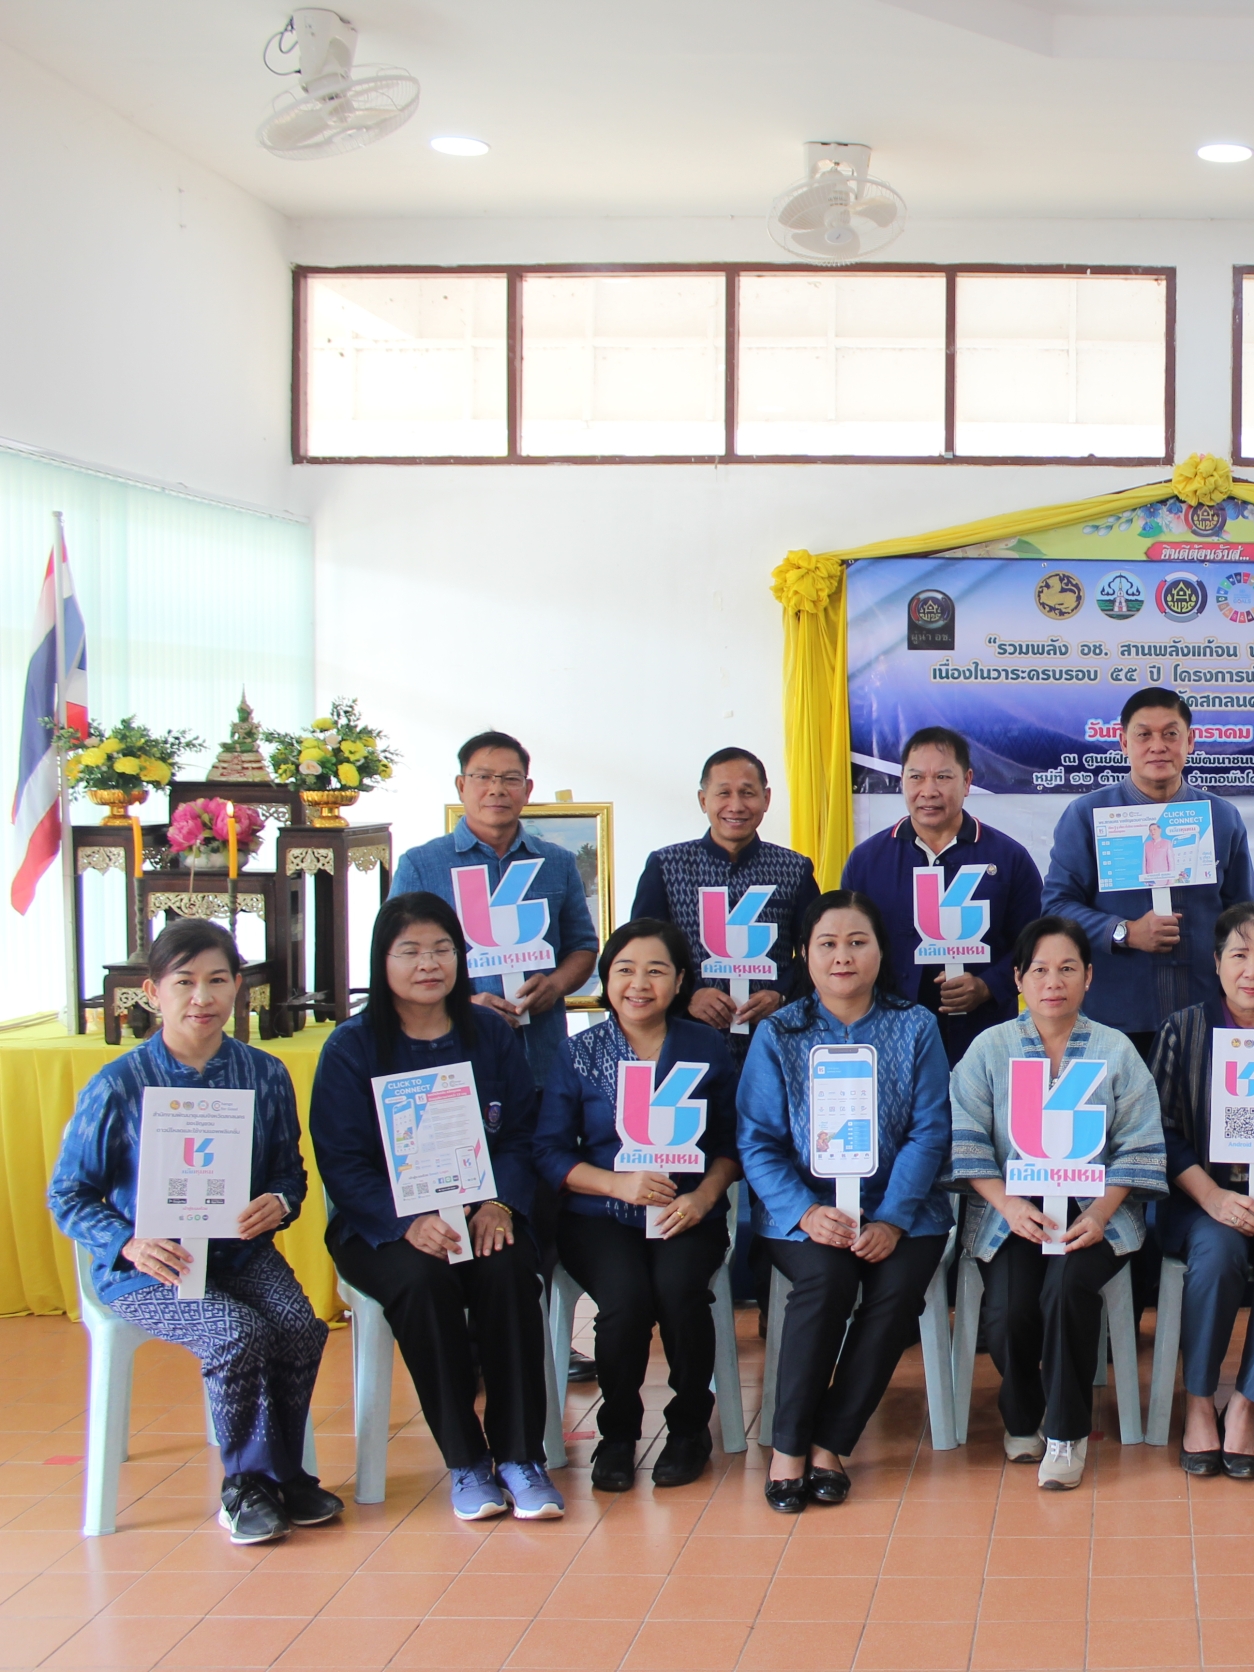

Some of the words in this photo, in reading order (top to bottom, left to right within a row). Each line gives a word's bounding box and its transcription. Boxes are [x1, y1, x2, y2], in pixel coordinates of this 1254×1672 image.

[1080, 643, 1109, 657] อช.
[1120, 639, 1238, 657] สานพลังแก้จน
[932, 659, 1098, 681] เนื่องในวาระครบรอบ
[1110, 666, 1138, 682] ๕๕
[1149, 664, 1161, 682] ปี
[1192, 726, 1251, 739] กราคม
[1063, 754, 1077, 764] ณ
[1034, 768, 1063, 786] หมู่ที่
[1071, 772, 1093, 784] ๑๒
[1163, 810, 1184, 819] CLICK
[1169, 816, 1203, 825] CONNECT
[467, 949, 551, 969] คลิกชุมชน
[918, 943, 985, 959] คลิกชุมชน
[703, 961, 772, 977] คลิกชุมชน
[388, 1080, 411, 1089] CLICK
[394, 1084, 431, 1096] CONNECT
[620, 1149, 699, 1168] คลิกชุมชน
[1009, 1163, 1104, 1187] คลิกชุมชน
